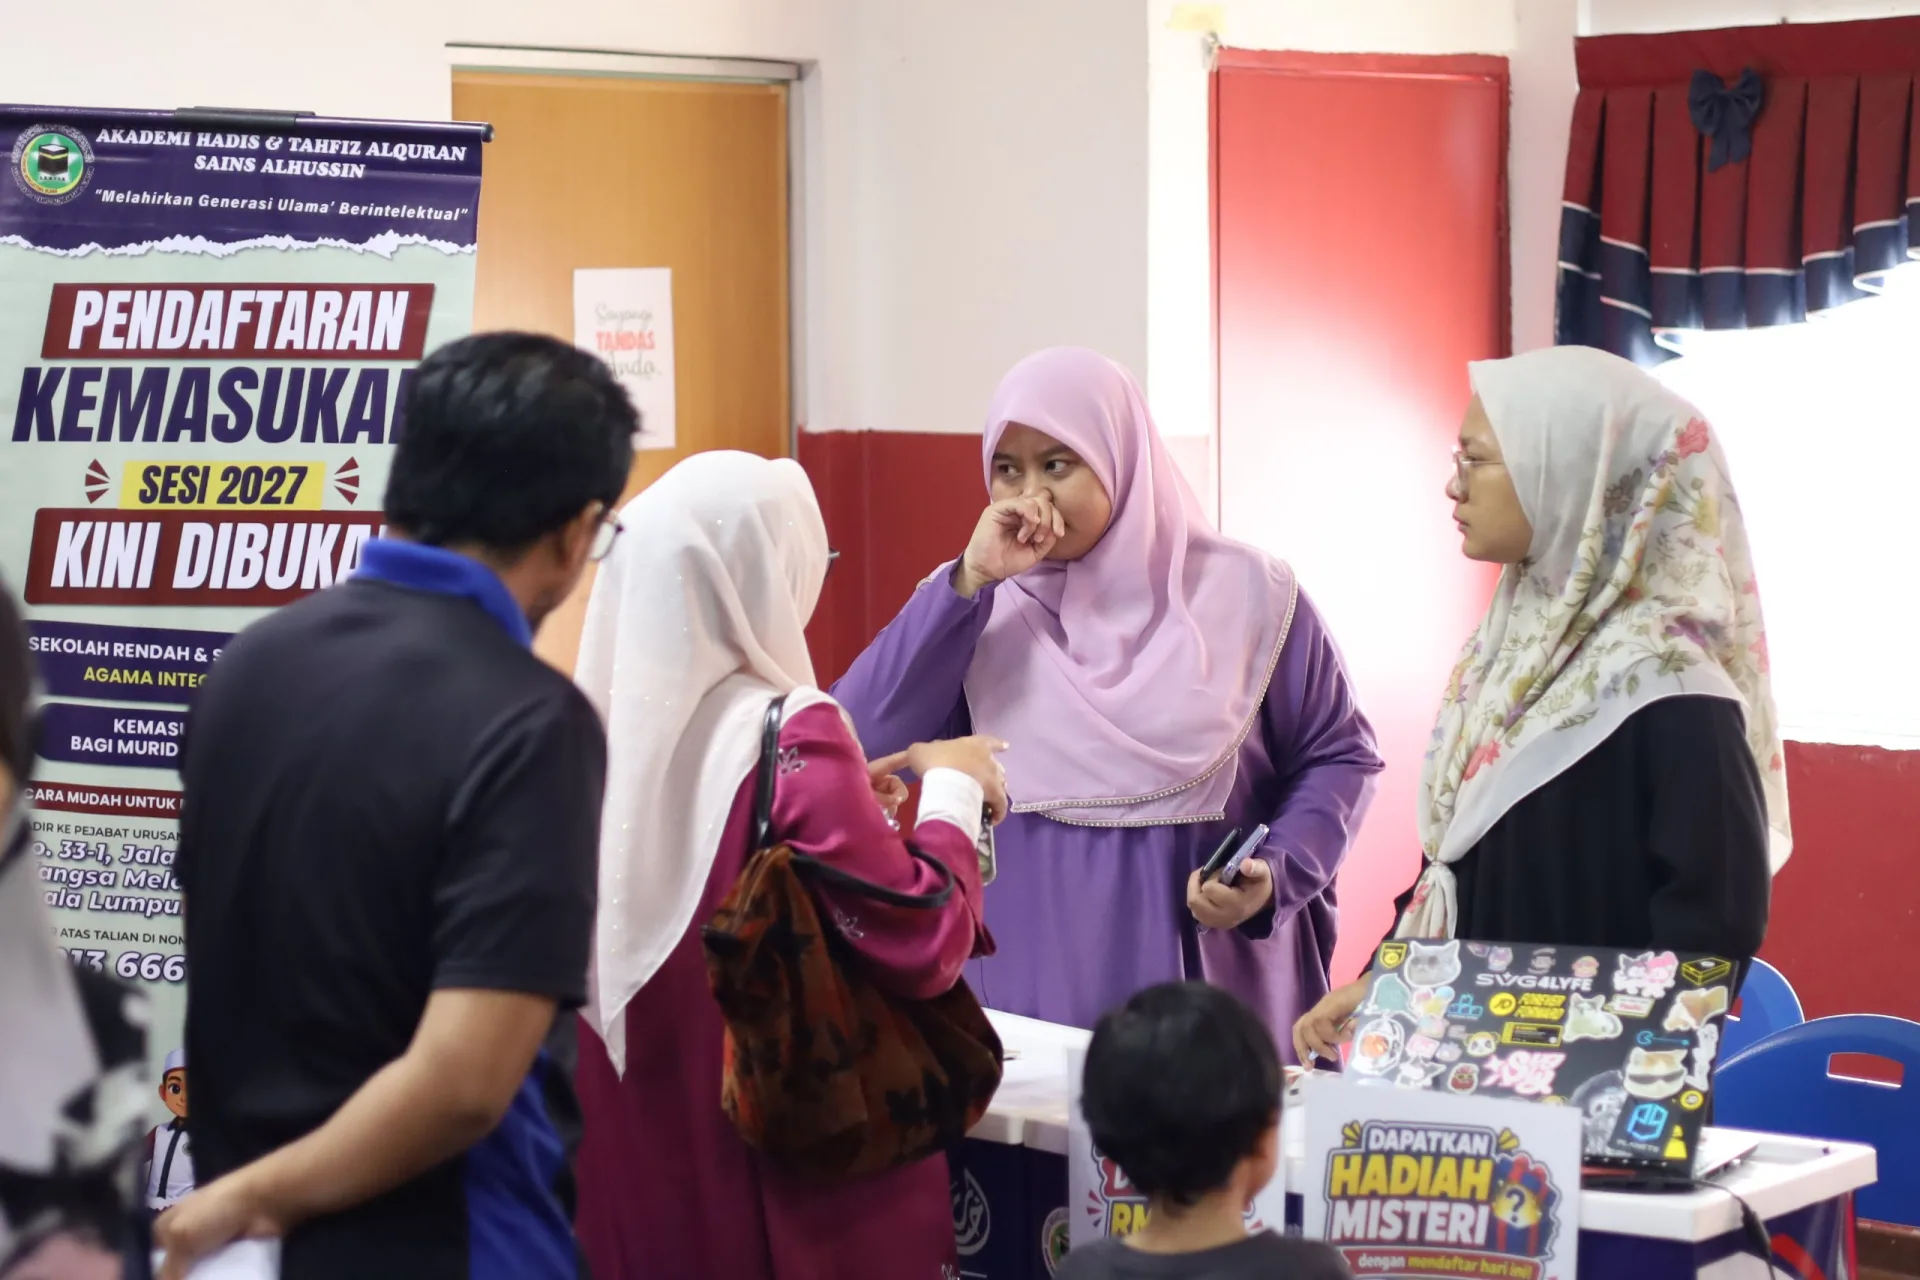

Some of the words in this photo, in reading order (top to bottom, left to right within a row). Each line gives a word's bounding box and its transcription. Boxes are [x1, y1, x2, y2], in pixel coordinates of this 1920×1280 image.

[96, 128, 192, 147] AKADEMI
[196, 132, 260, 150] HADIS
[265, 136, 283, 151] &
[288, 137, 361, 156] TAHFIZ
[365, 142, 467, 161] ALQURAN
[194, 155, 256, 173] SAINS
[260, 158, 366, 178] ALHUSSIN
[198, 194, 274, 210] Generasi
[68, 290, 409, 351] PENDAFTARAN
[138, 465, 211, 504] SESI
[216, 465, 308, 505] 2027
[50, 521, 163, 589] KINI
[172, 522, 388, 590] DIBUKA
[28, 636, 109, 656] SEKOLAH
[113, 642, 190, 661] RENDAH
[194, 647, 208, 662] &
[84, 666, 153, 685] AGAMA
[70, 736, 113, 753] BAGI
[117, 739, 179, 757] MURID
[67, 791, 121, 807] MUDAH
[125, 795, 176, 810] UNTUK
[57, 824, 71, 834] KE
[75, 825, 129, 838] PEJABAT
[37, 864, 117, 888] angsa
[88, 891, 184, 918] Lumpu
[60, 927, 91, 939] ATAS
[94, 930, 139, 942] TALIAN
[143, 933, 155, 944] DI
[1368, 1127, 1490, 1155] DAPATKAN
[1330, 1153, 1495, 1200] HADIAH
[1331, 1199, 1491, 1246] MISTERI
[1358, 1253, 1405, 1271] dengan
